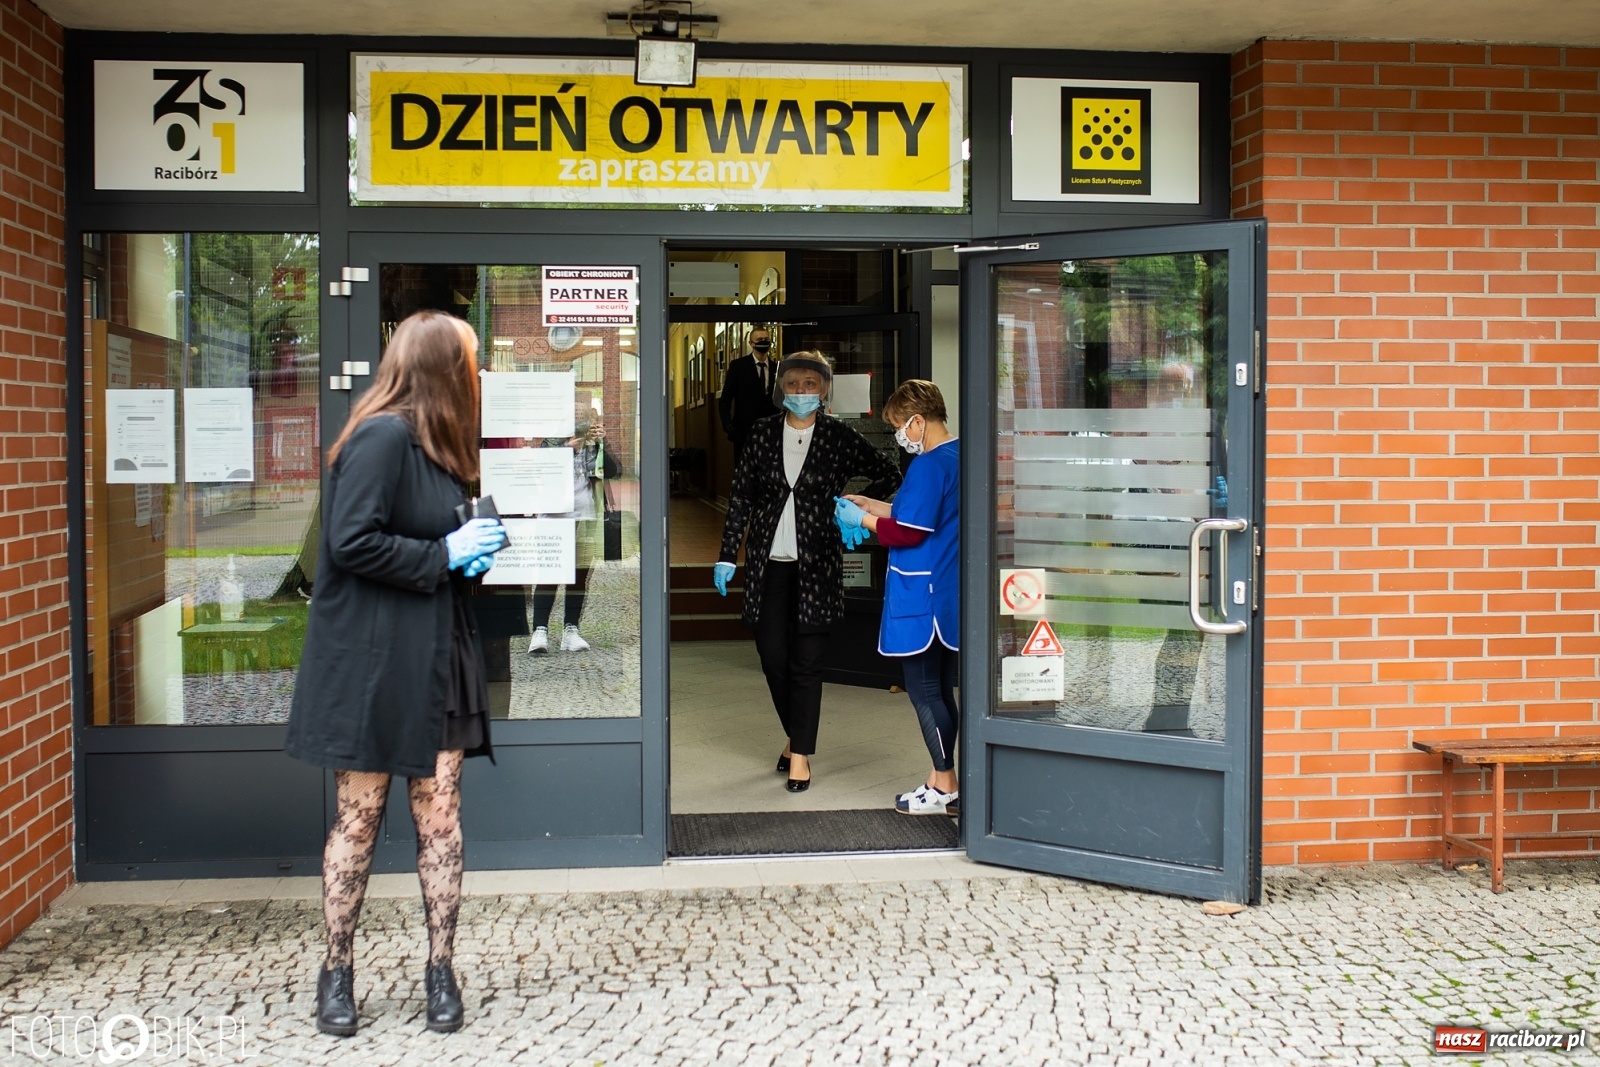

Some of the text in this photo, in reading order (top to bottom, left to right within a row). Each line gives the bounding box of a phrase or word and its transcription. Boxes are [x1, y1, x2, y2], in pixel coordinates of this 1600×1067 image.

[390, 83, 936, 157] DZIEŃ OTWARTY
[154, 167, 218, 180] Racibórz
[558, 157, 771, 190] zapraszamy
[1107, 178, 1142, 186] Plastycznych
[549, 270, 629, 278] OBIEKT CHRONIONY
[549, 288, 628, 300] PARTNER
[595, 303, 629, 311] security
